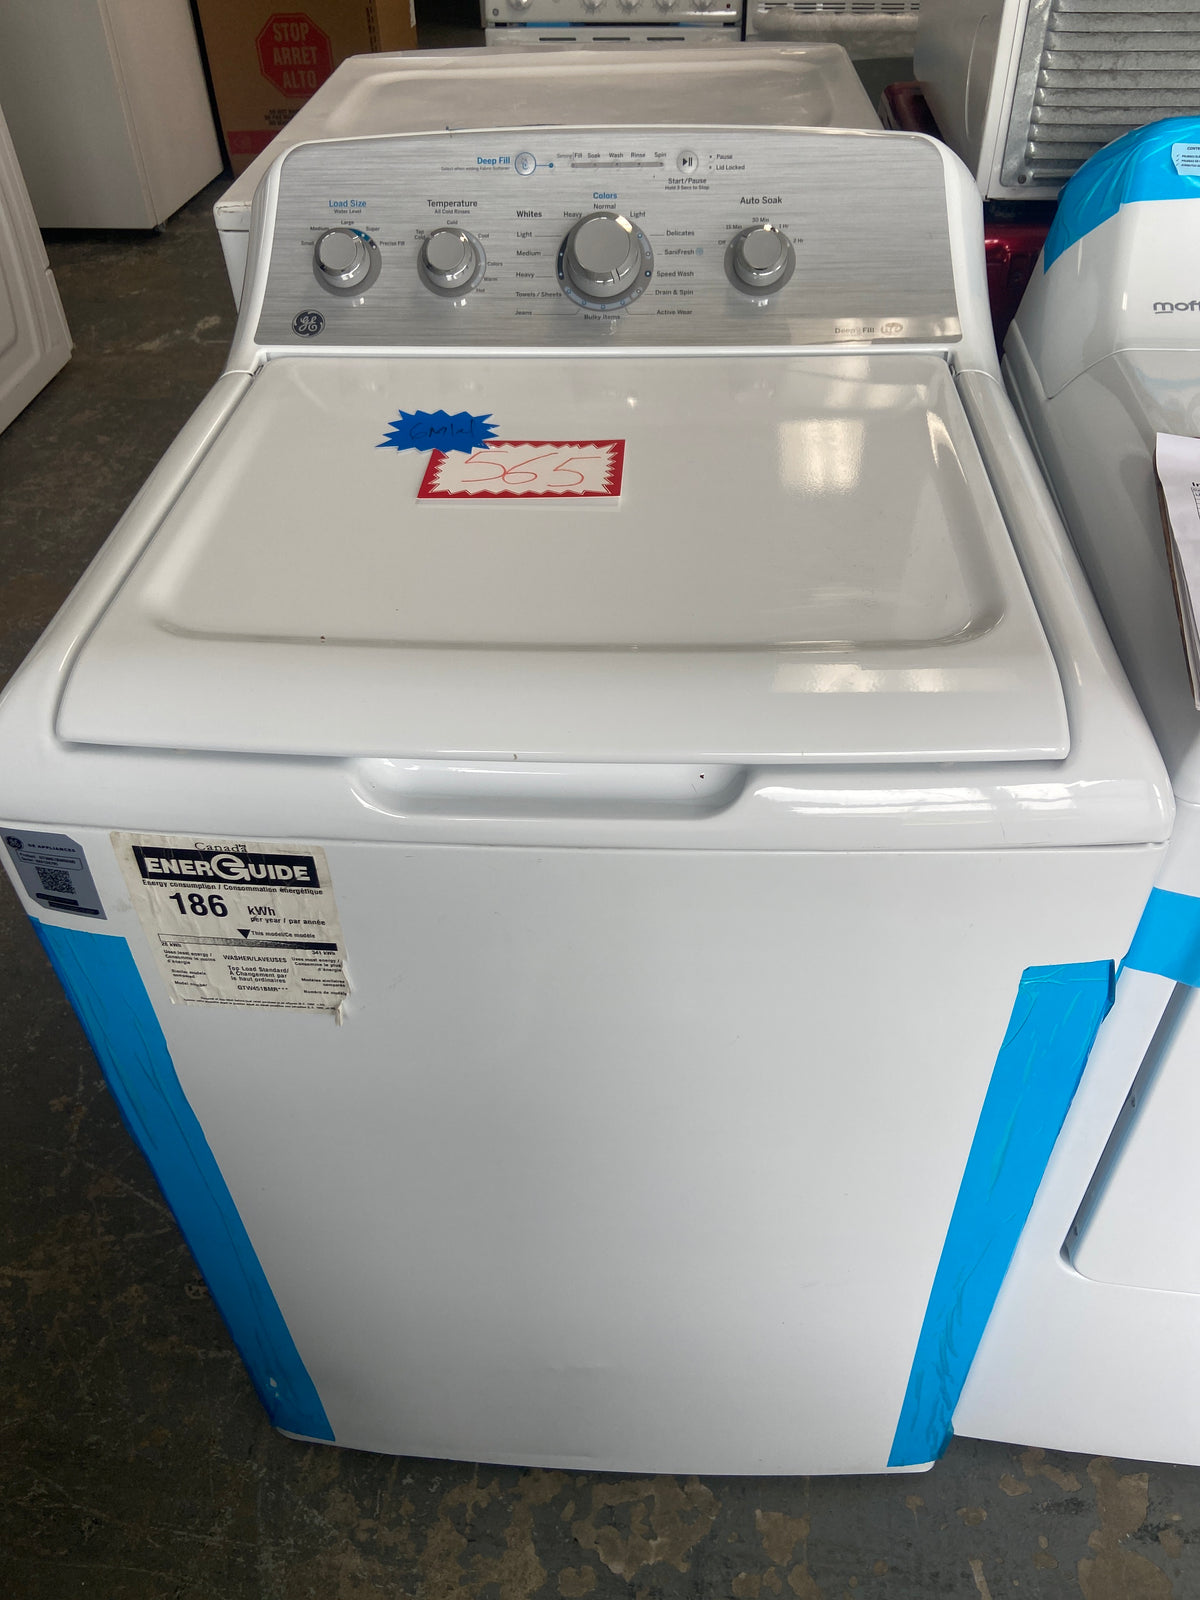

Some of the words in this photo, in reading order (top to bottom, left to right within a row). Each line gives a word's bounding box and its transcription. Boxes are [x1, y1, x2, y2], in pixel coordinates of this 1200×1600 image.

[273, 22, 310, 42] STOP
[273, 47, 317, 66] ARRET
[282, 71, 317, 89] ALTO
[654, 151, 667, 159] Spin
[477, 156, 497, 165] Deep
[498, 156, 510, 164] Fill
[668, 177, 707, 185] Start/Pause
[328, 199, 348, 208] Load
[350, 199, 367, 208] Size
[427, 199, 478, 208] Temperature
[740, 196, 760, 205] Auto
[762, 196, 783, 204] Soak
[516, 210, 542, 218] Whites
[563, 211, 582, 219] Heavy
[630, 211, 646, 219] Light
[517, 231, 532, 239] Light
[664, 248, 695, 256] SaniFresh
[515, 271, 535, 279] Heavy
[656, 269, 676, 277] Speed
[655, 287, 672, 296] Drain
[680, 287, 694, 296] Spin
[583, 313, 601, 321] Bulky
[460, 449, 602, 488] 565
[194, 841, 248, 853] Canada
[144, 853, 311, 882] ENERGUIDE
[142, 879, 169, 888] Energy
[169, 882, 217, 890] consumption
[223, 884, 278, 893] Consommation
[169, 892, 229, 918] 186
[247, 905, 277, 916] kWh
